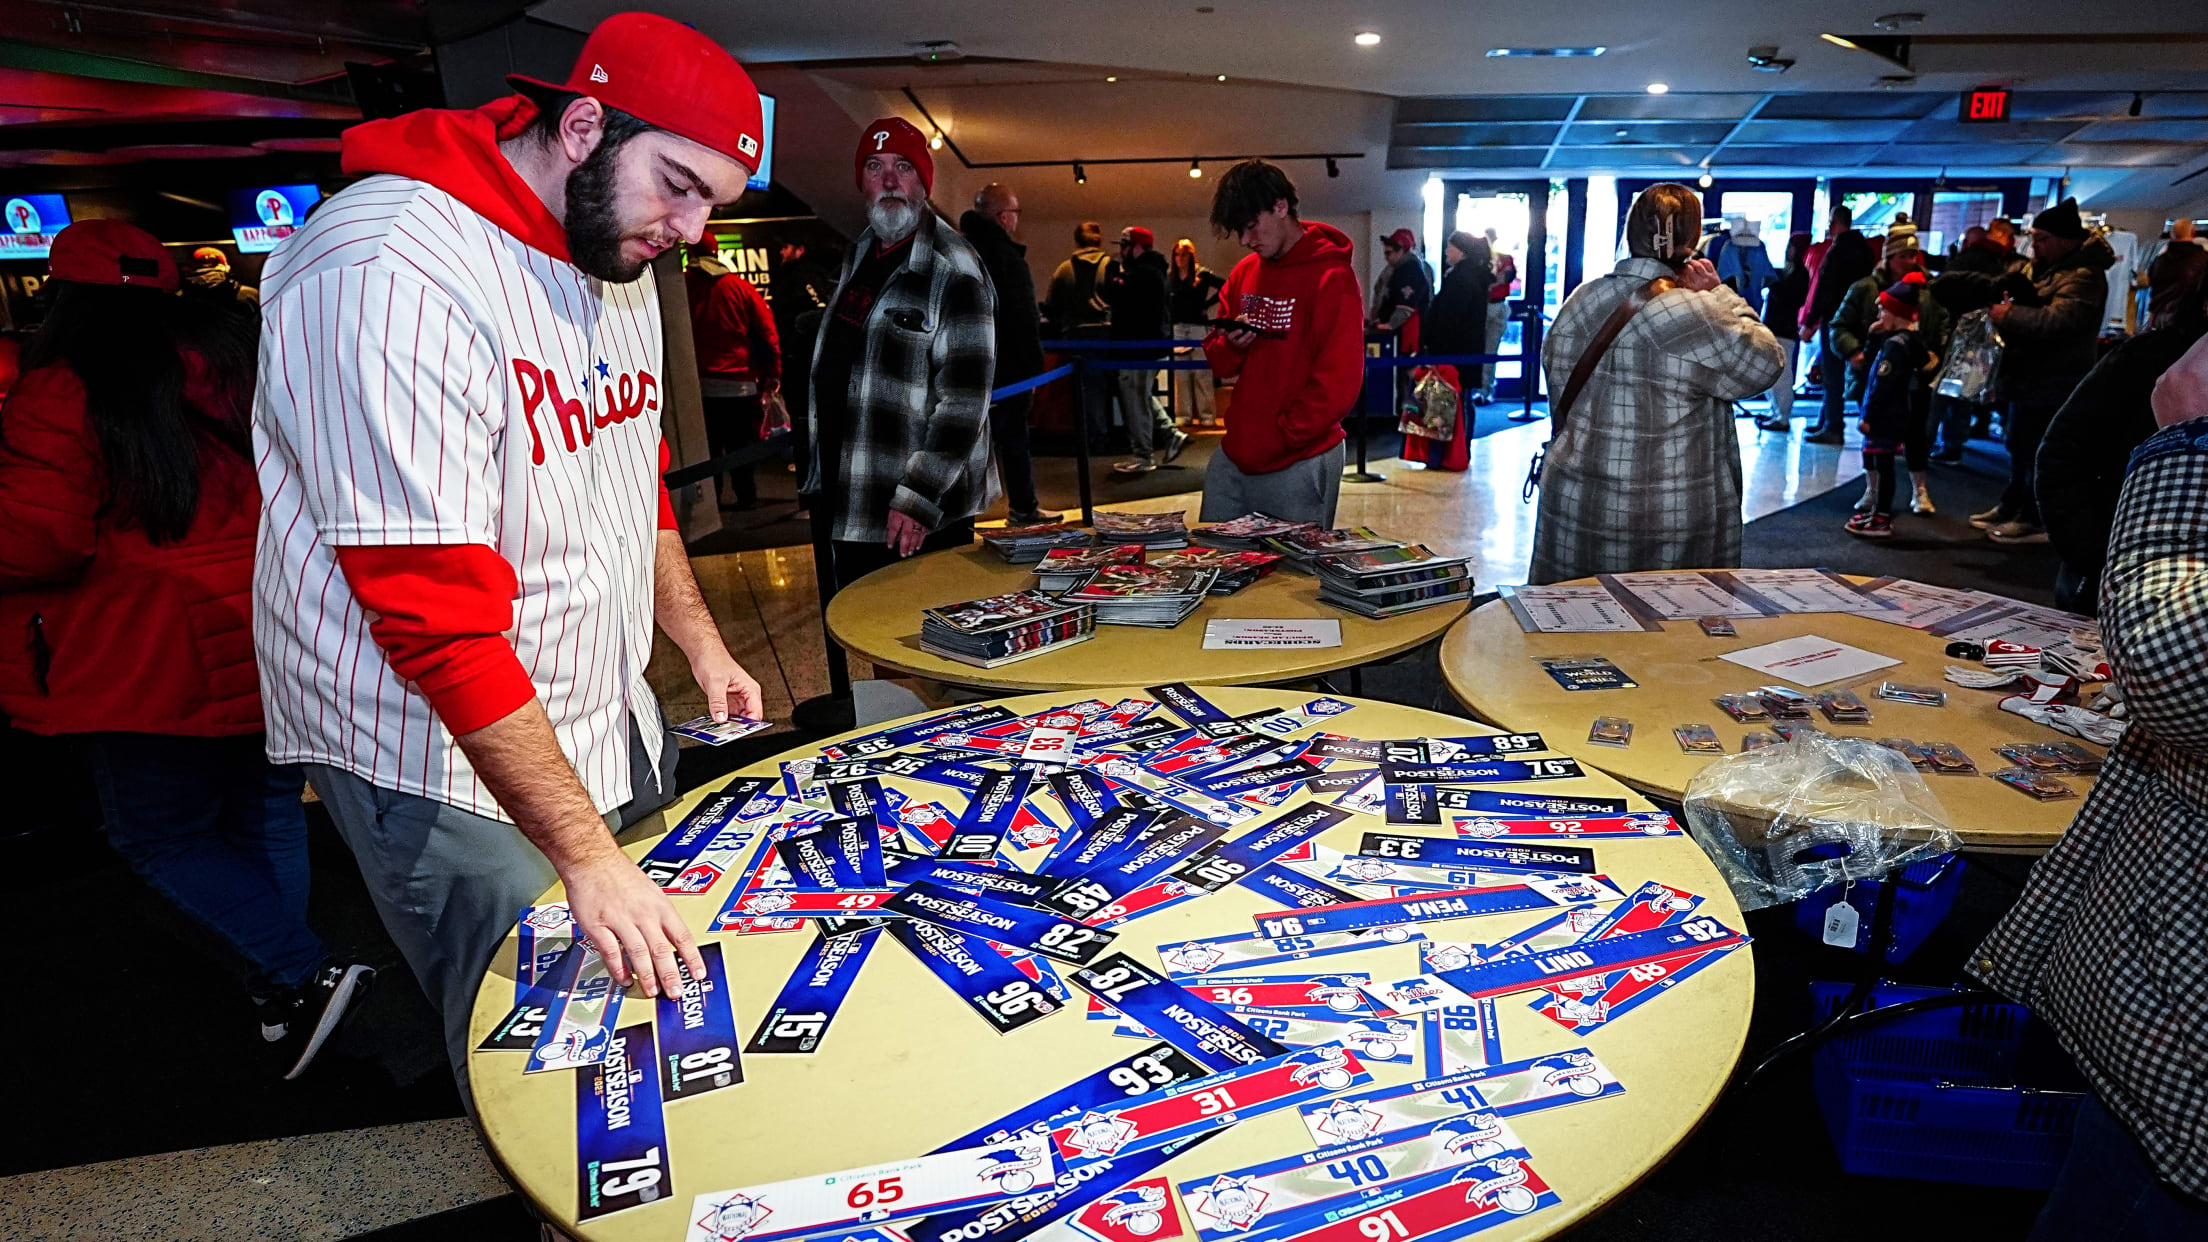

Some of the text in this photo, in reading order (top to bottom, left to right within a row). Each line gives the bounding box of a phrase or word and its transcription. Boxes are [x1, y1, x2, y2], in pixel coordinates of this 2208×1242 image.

[1970, 92, 2007, 118] EXIT
[873, 131, 890, 150] P
[15, 206, 29, 228] P
[266, 198, 282, 220] P
[717, 248, 769, 273] KIN
[856, 738, 895, 754] 39
[1322, 745, 1381, 757] POSTSE
[1493, 735, 1530, 750] 89
[885, 758, 925, 775] 56
[1387, 747, 1419, 763] 20
[830, 763, 868, 778] 92
[1394, 769, 1499, 778] POSTSEASON
[1524, 760, 1566, 776] 76
[847, 784, 870, 816] POSTSEAS
[978, 775, 1016, 823] POSTSEASON
[1407, 785, 1422, 820] POSTSEAS
[1500, 799, 1614, 814] POSTSEASON
[676, 796, 735, 846] POSTSEASON
[1248, 810, 1330, 851] POSTSEASON
[1550, 820, 1584, 832] 92
[956, 835, 997, 853] 00
[1076, 812, 1139, 864] POSTSEASON
[1380, 840, 1421, 859] 33
[1119, 825, 1206, 875] POSTSEASON
[1456, 847, 1581, 865] POSTSEASON
[930, 868, 1041, 896] POSTSEASON
[1197, 859, 1246, 882] 90
[1448, 872, 1475, 885] 61
[837, 895, 877, 908] 49
[1063, 883, 1112, 911] 48
[1403, 898, 1469, 916] PENA
[904, 892, 1019, 931] POSTSEASON
[1039, 923, 1096, 953] 82
[1264, 918, 1303, 937] 94
[1681, 920, 1728, 941] 92
[907, 918, 984, 977] POSTSEASON
[1534, 951, 1594, 974] LIND
[1090, 967, 1150, 1002] 78
[1212, 988, 1253, 1004] 36
[1386, 986, 1444, 1002] Phillies
[986, 981, 1043, 1016] 96
[774, 1011, 828, 1038] 15
[1220, 1025, 1246, 1041] 2025
[1248, 1017, 1290, 1040] 82
[681, 1047, 735, 1081] 81
[1109, 1056, 1173, 1095] 93
[604, 1036, 631, 1131] POSTSEASON
[1425, 1071, 1487, 1088] Citizens Bank Park
[1192, 1087, 1236, 1114] 31
[1441, 1085, 1488, 1109] 41
[1316, 1137, 1384, 1159] Citizens Bank Park
[601, 1146, 662, 1197] 79
[1327, 1155, 1389, 1186] 40
[847, 1177, 904, 1209] 65
[1022, 1201, 1058, 1222] 2025
[1359, 1210, 1409, 1242] 91
